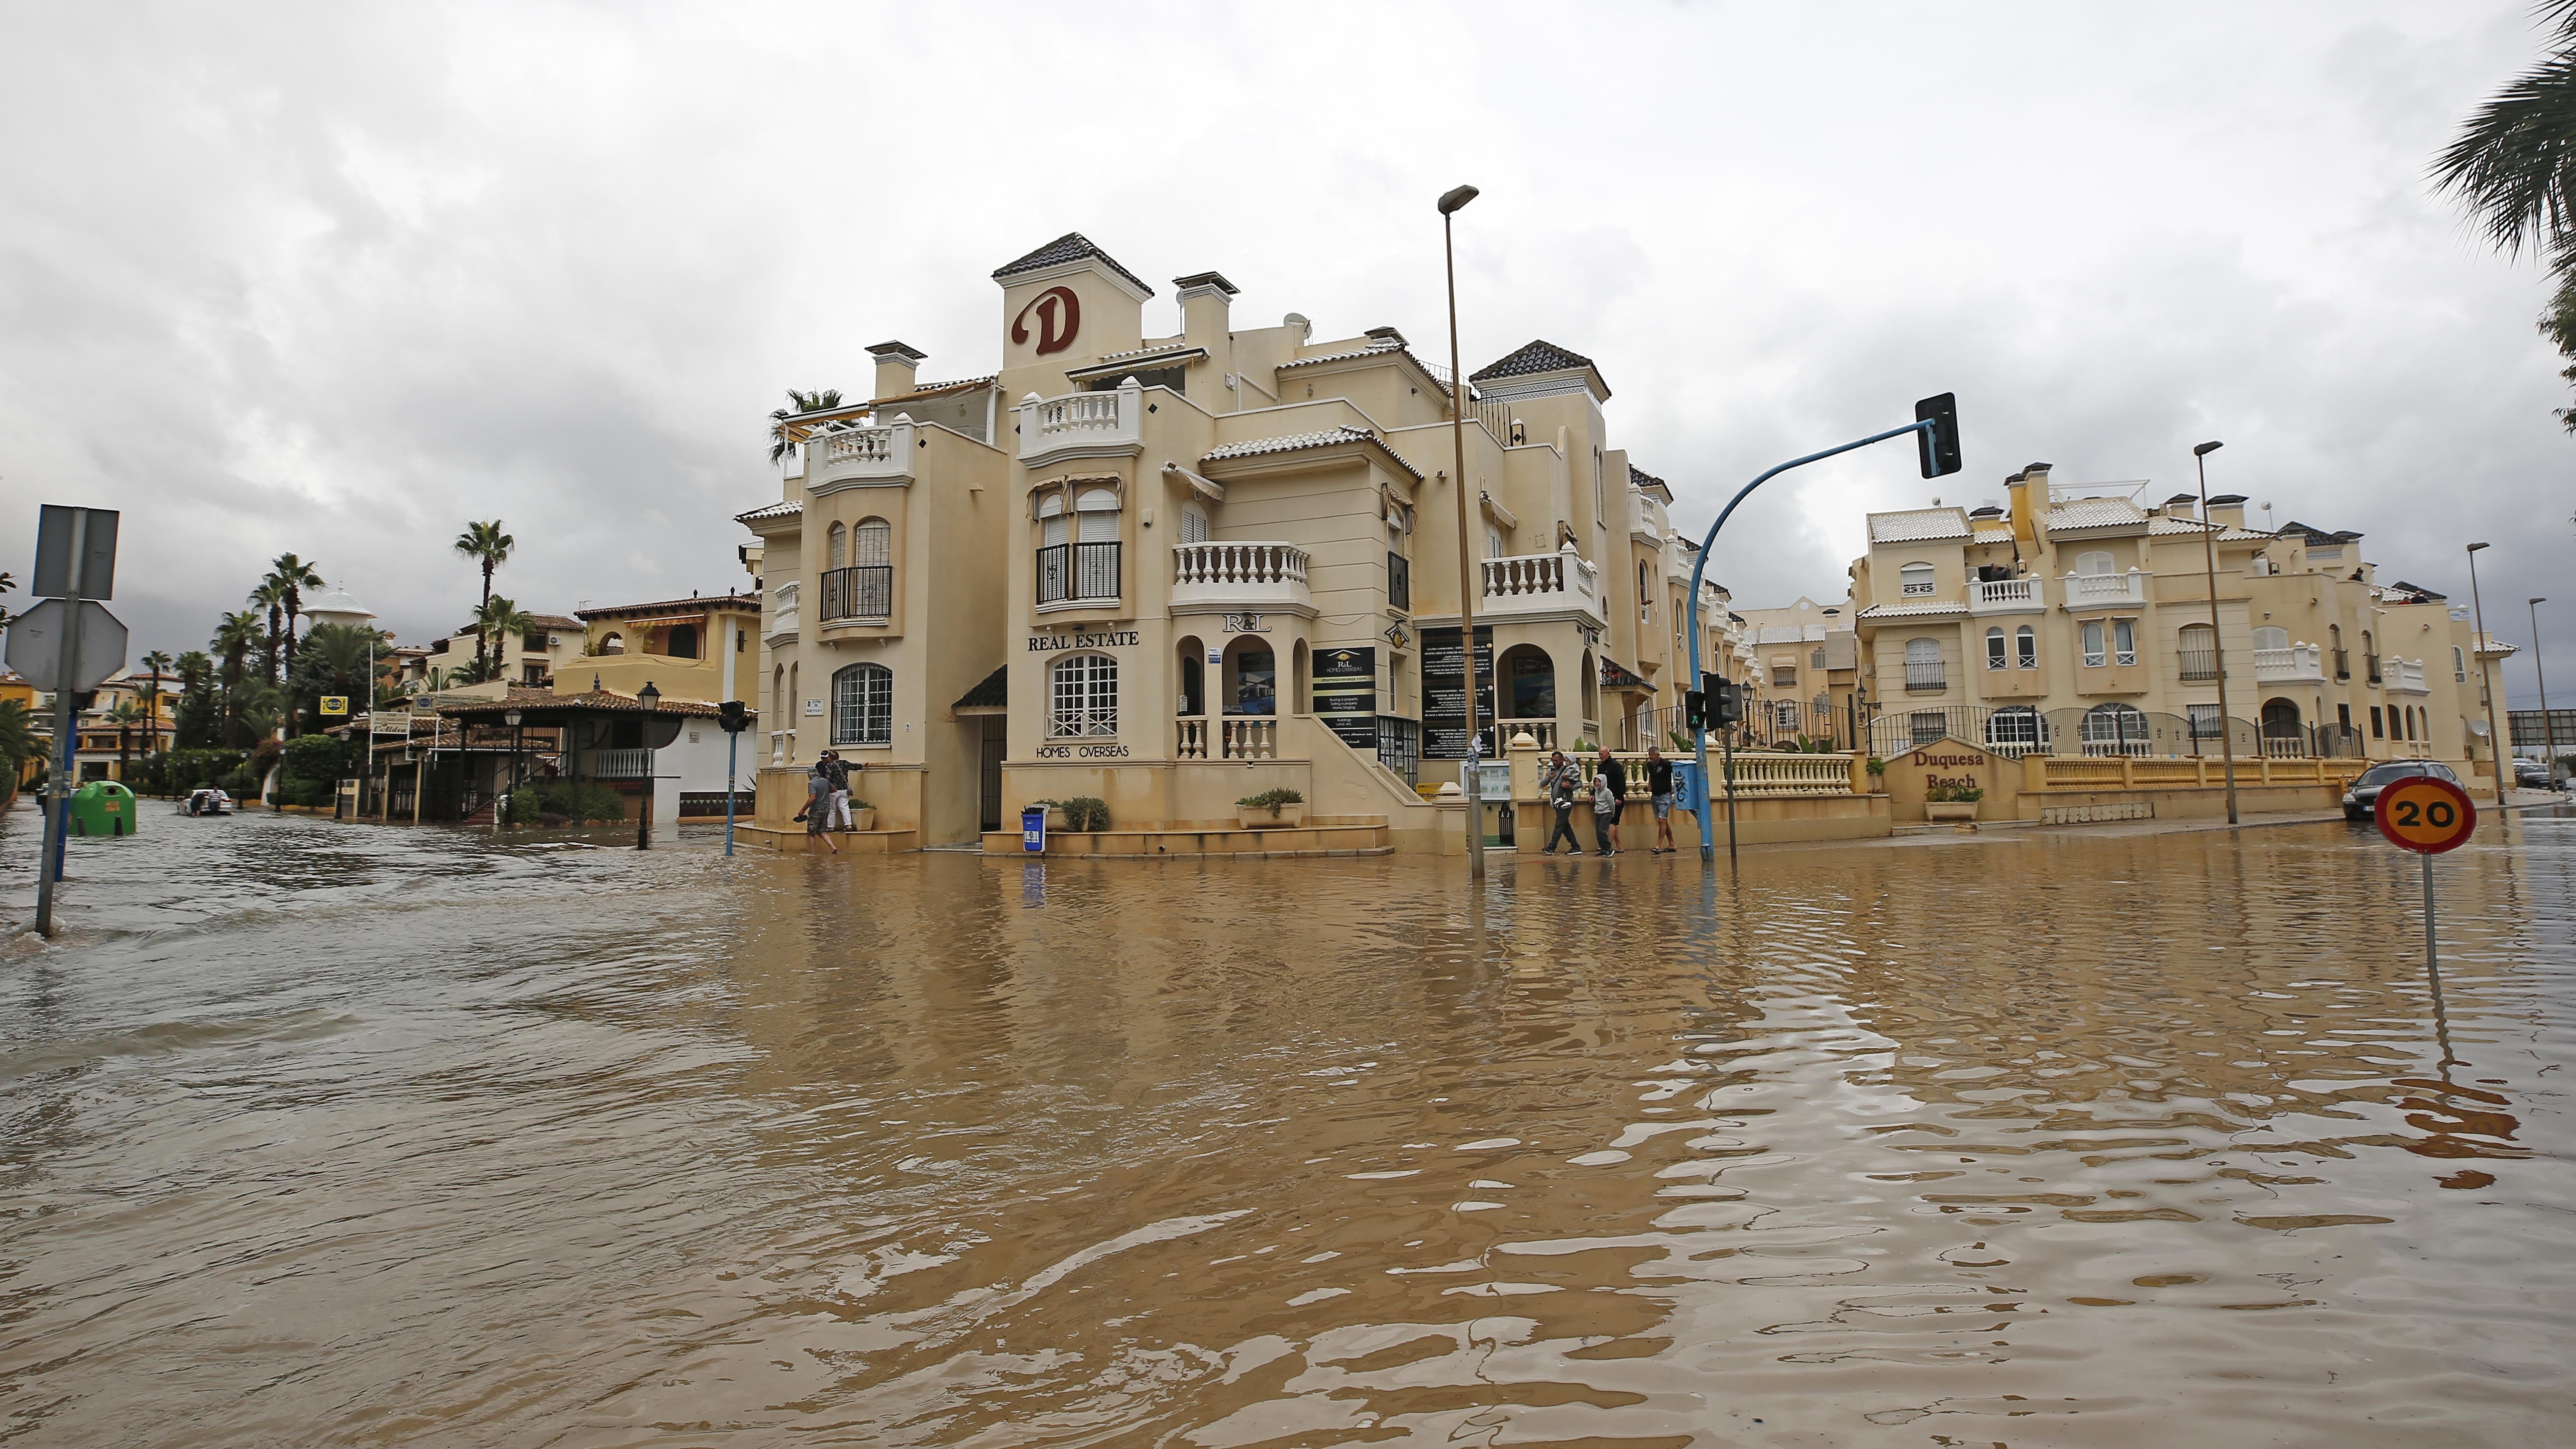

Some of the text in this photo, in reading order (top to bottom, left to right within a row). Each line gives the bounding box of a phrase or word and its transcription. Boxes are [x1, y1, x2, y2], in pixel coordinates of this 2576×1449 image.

[1011, 286, 1080, 355] D
[1028, 631, 1139, 651] REAL ESTATE
[1037, 746, 1129, 758] HOMES OVERSEAS
[1914, 751, 1984, 770] Duquesa
[1926, 774, 1976, 788] Beach
[2395, 800, 2455, 828] 20
